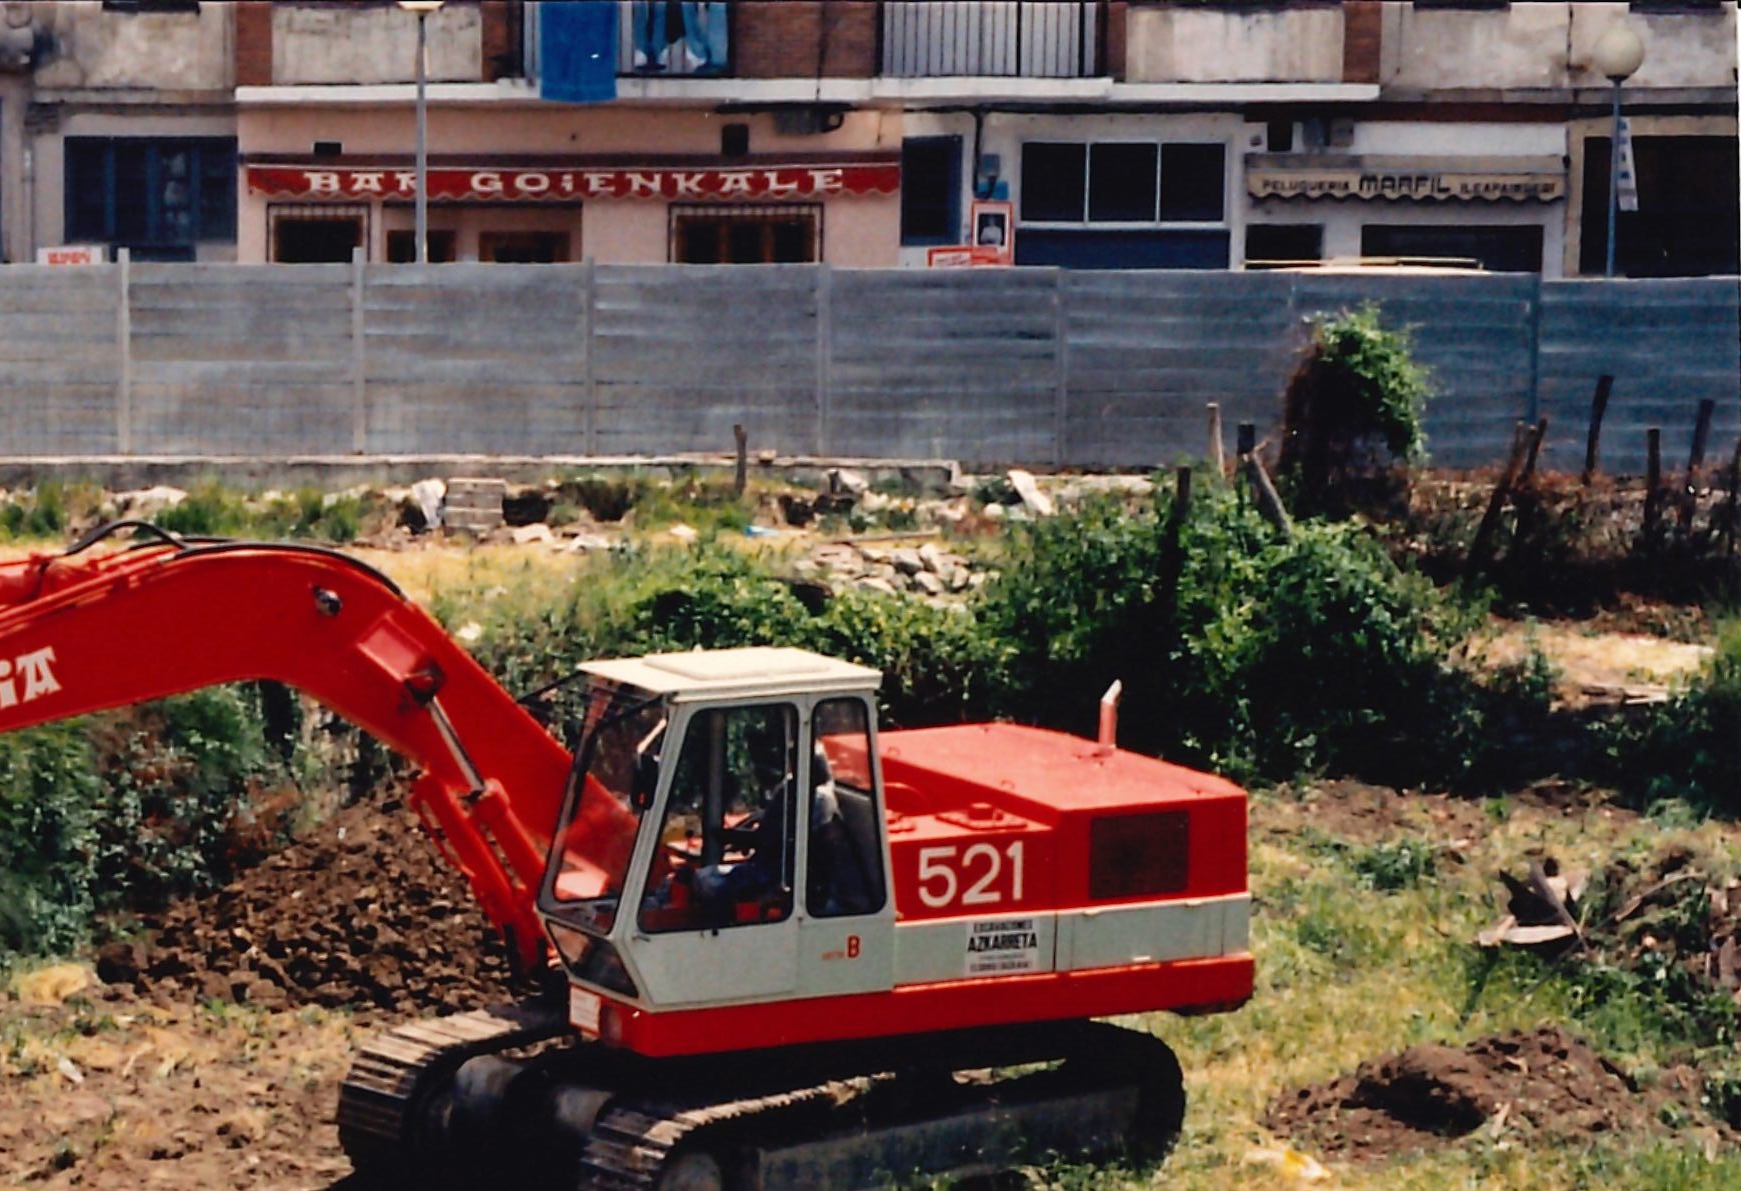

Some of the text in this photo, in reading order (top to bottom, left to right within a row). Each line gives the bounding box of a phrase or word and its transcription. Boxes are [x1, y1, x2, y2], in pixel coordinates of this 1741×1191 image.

[304, 172, 417, 193] BAR
[1359, 175, 1451, 194] MARFIL
[918, 840, 1024, 908] 521
